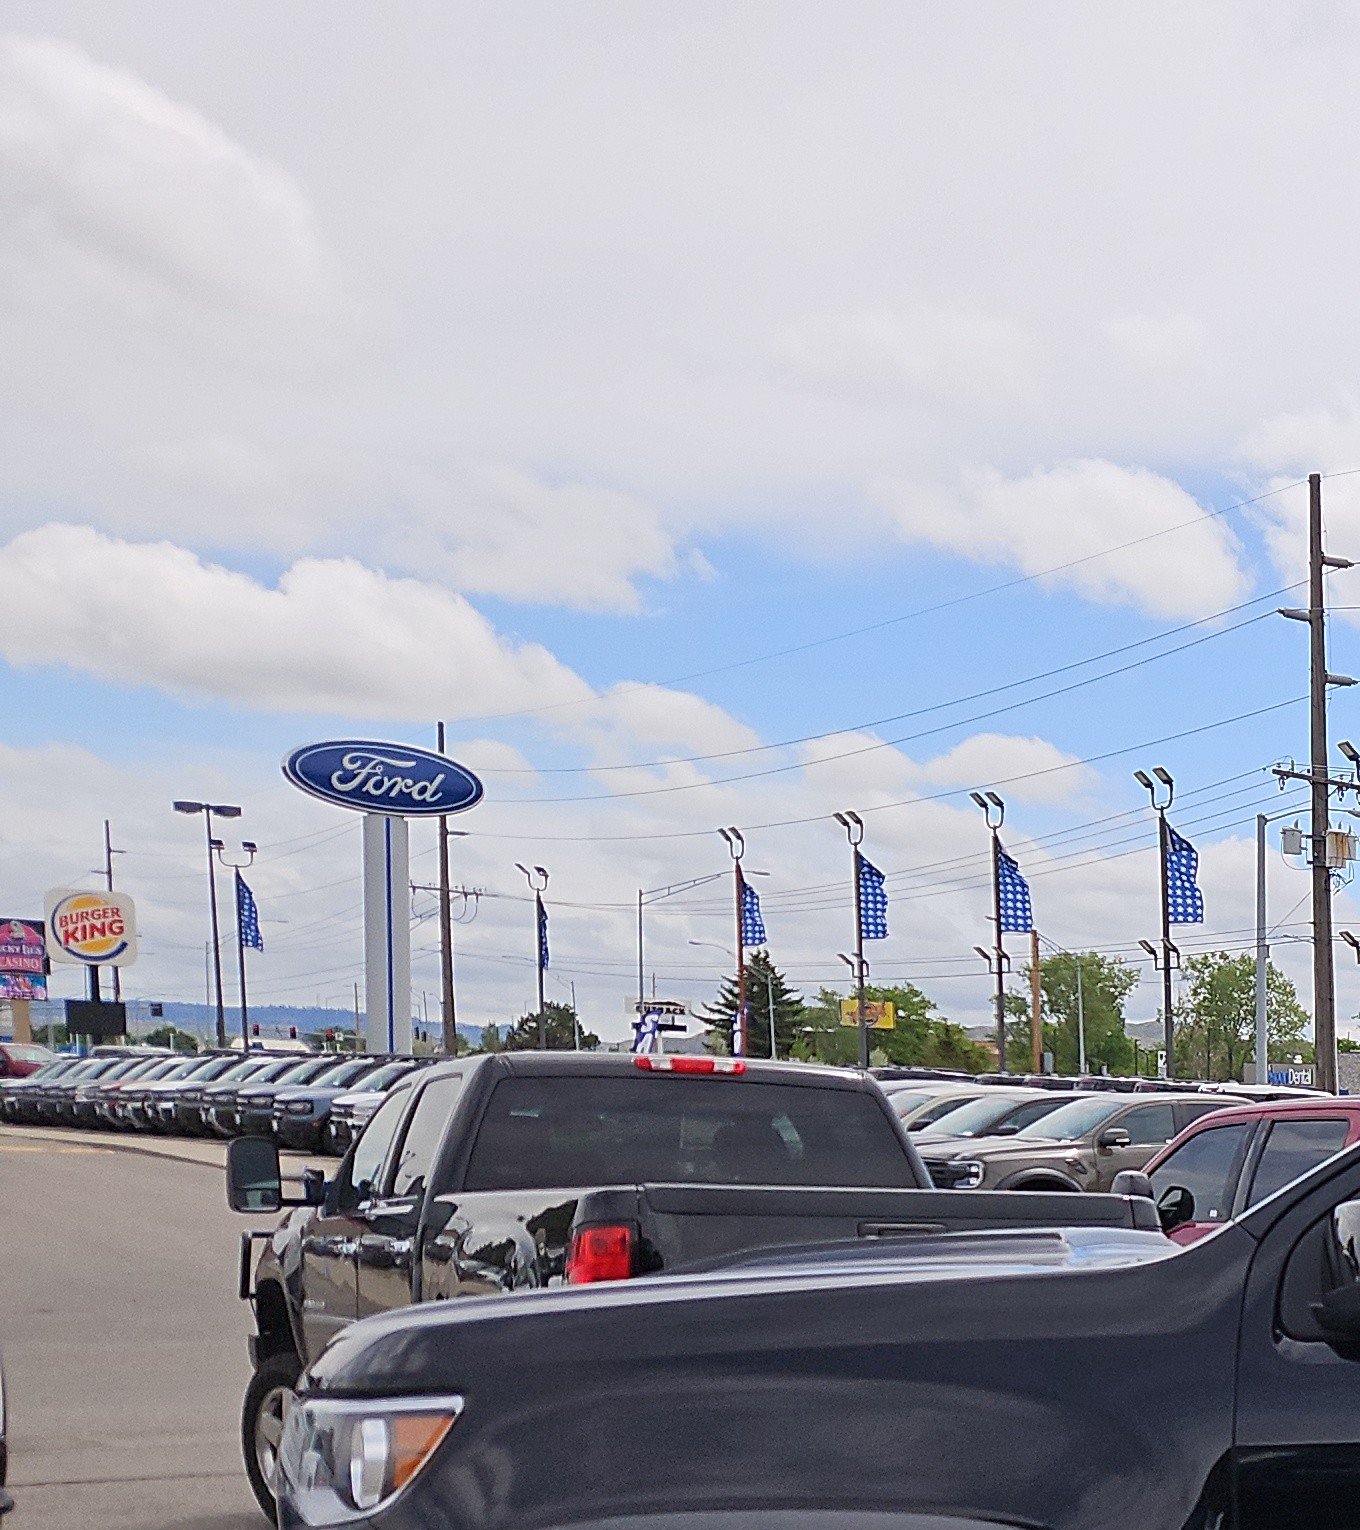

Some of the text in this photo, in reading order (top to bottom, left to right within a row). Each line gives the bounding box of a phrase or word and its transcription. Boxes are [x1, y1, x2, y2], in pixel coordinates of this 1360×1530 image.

[330, 752, 446, 802] Ford
[59, 907, 121, 928] BURGER
[63, 919, 124, 947] KING
[1288, 1068, 1312, 1085] Dental
